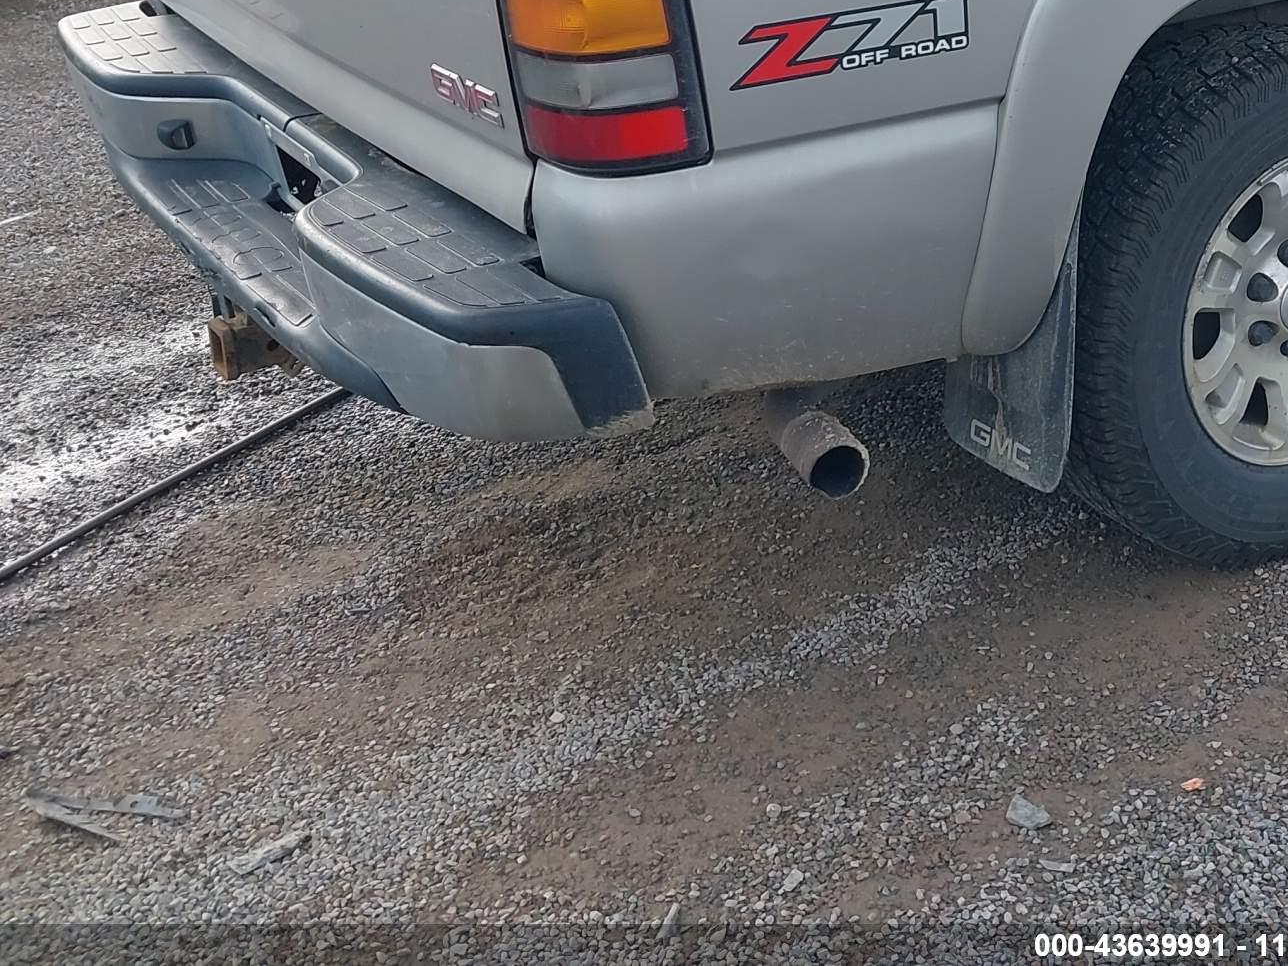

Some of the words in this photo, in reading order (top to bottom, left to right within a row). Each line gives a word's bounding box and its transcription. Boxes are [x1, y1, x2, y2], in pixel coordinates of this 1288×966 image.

[841, 48, 890, 70] OFF
[900, 35, 969, 59] ROAD
[430, 62, 504, 130] GMC
[970, 418, 1032, 472] GMC
